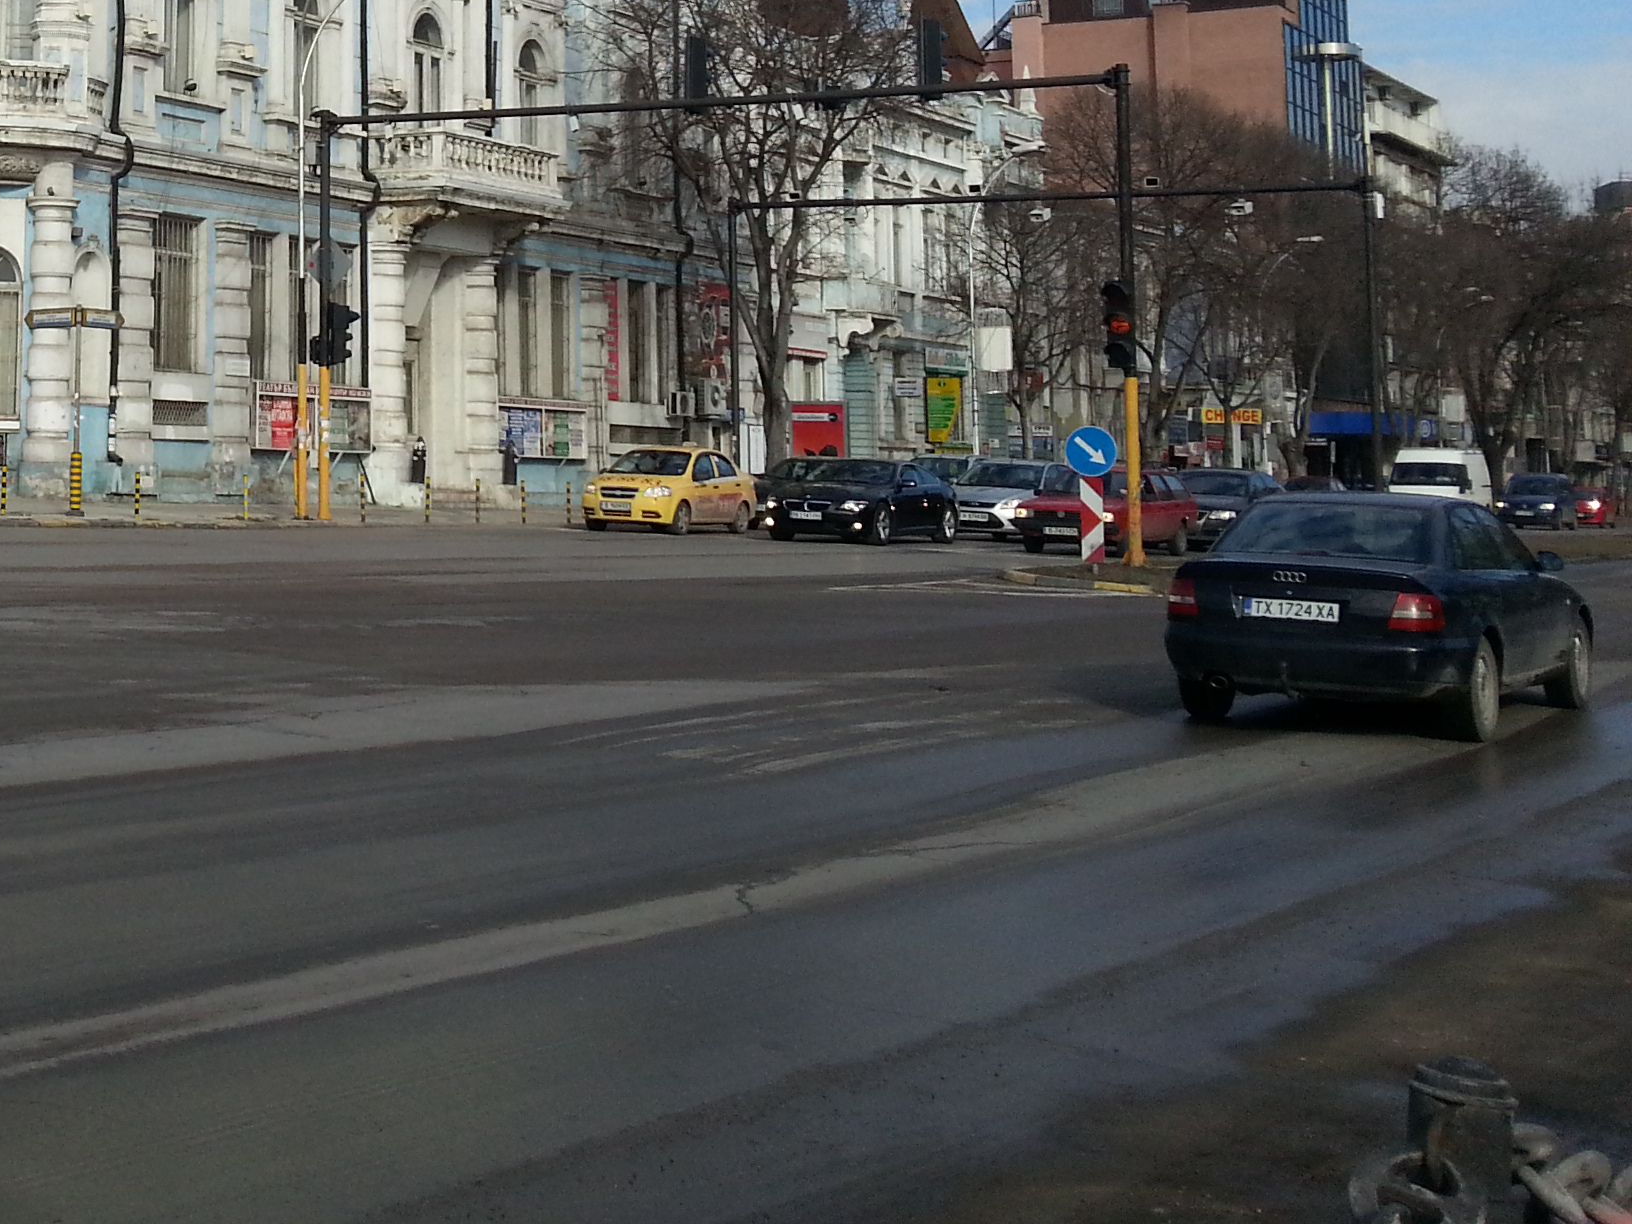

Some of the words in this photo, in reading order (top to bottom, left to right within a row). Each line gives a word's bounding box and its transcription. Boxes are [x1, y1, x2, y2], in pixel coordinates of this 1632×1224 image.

[1205, 409, 1259, 423] CHNGE
[1254, 600, 1273, 615] TX
[1277, 602, 1313, 618] 1724
[1315, 604, 1336, 620] XA
